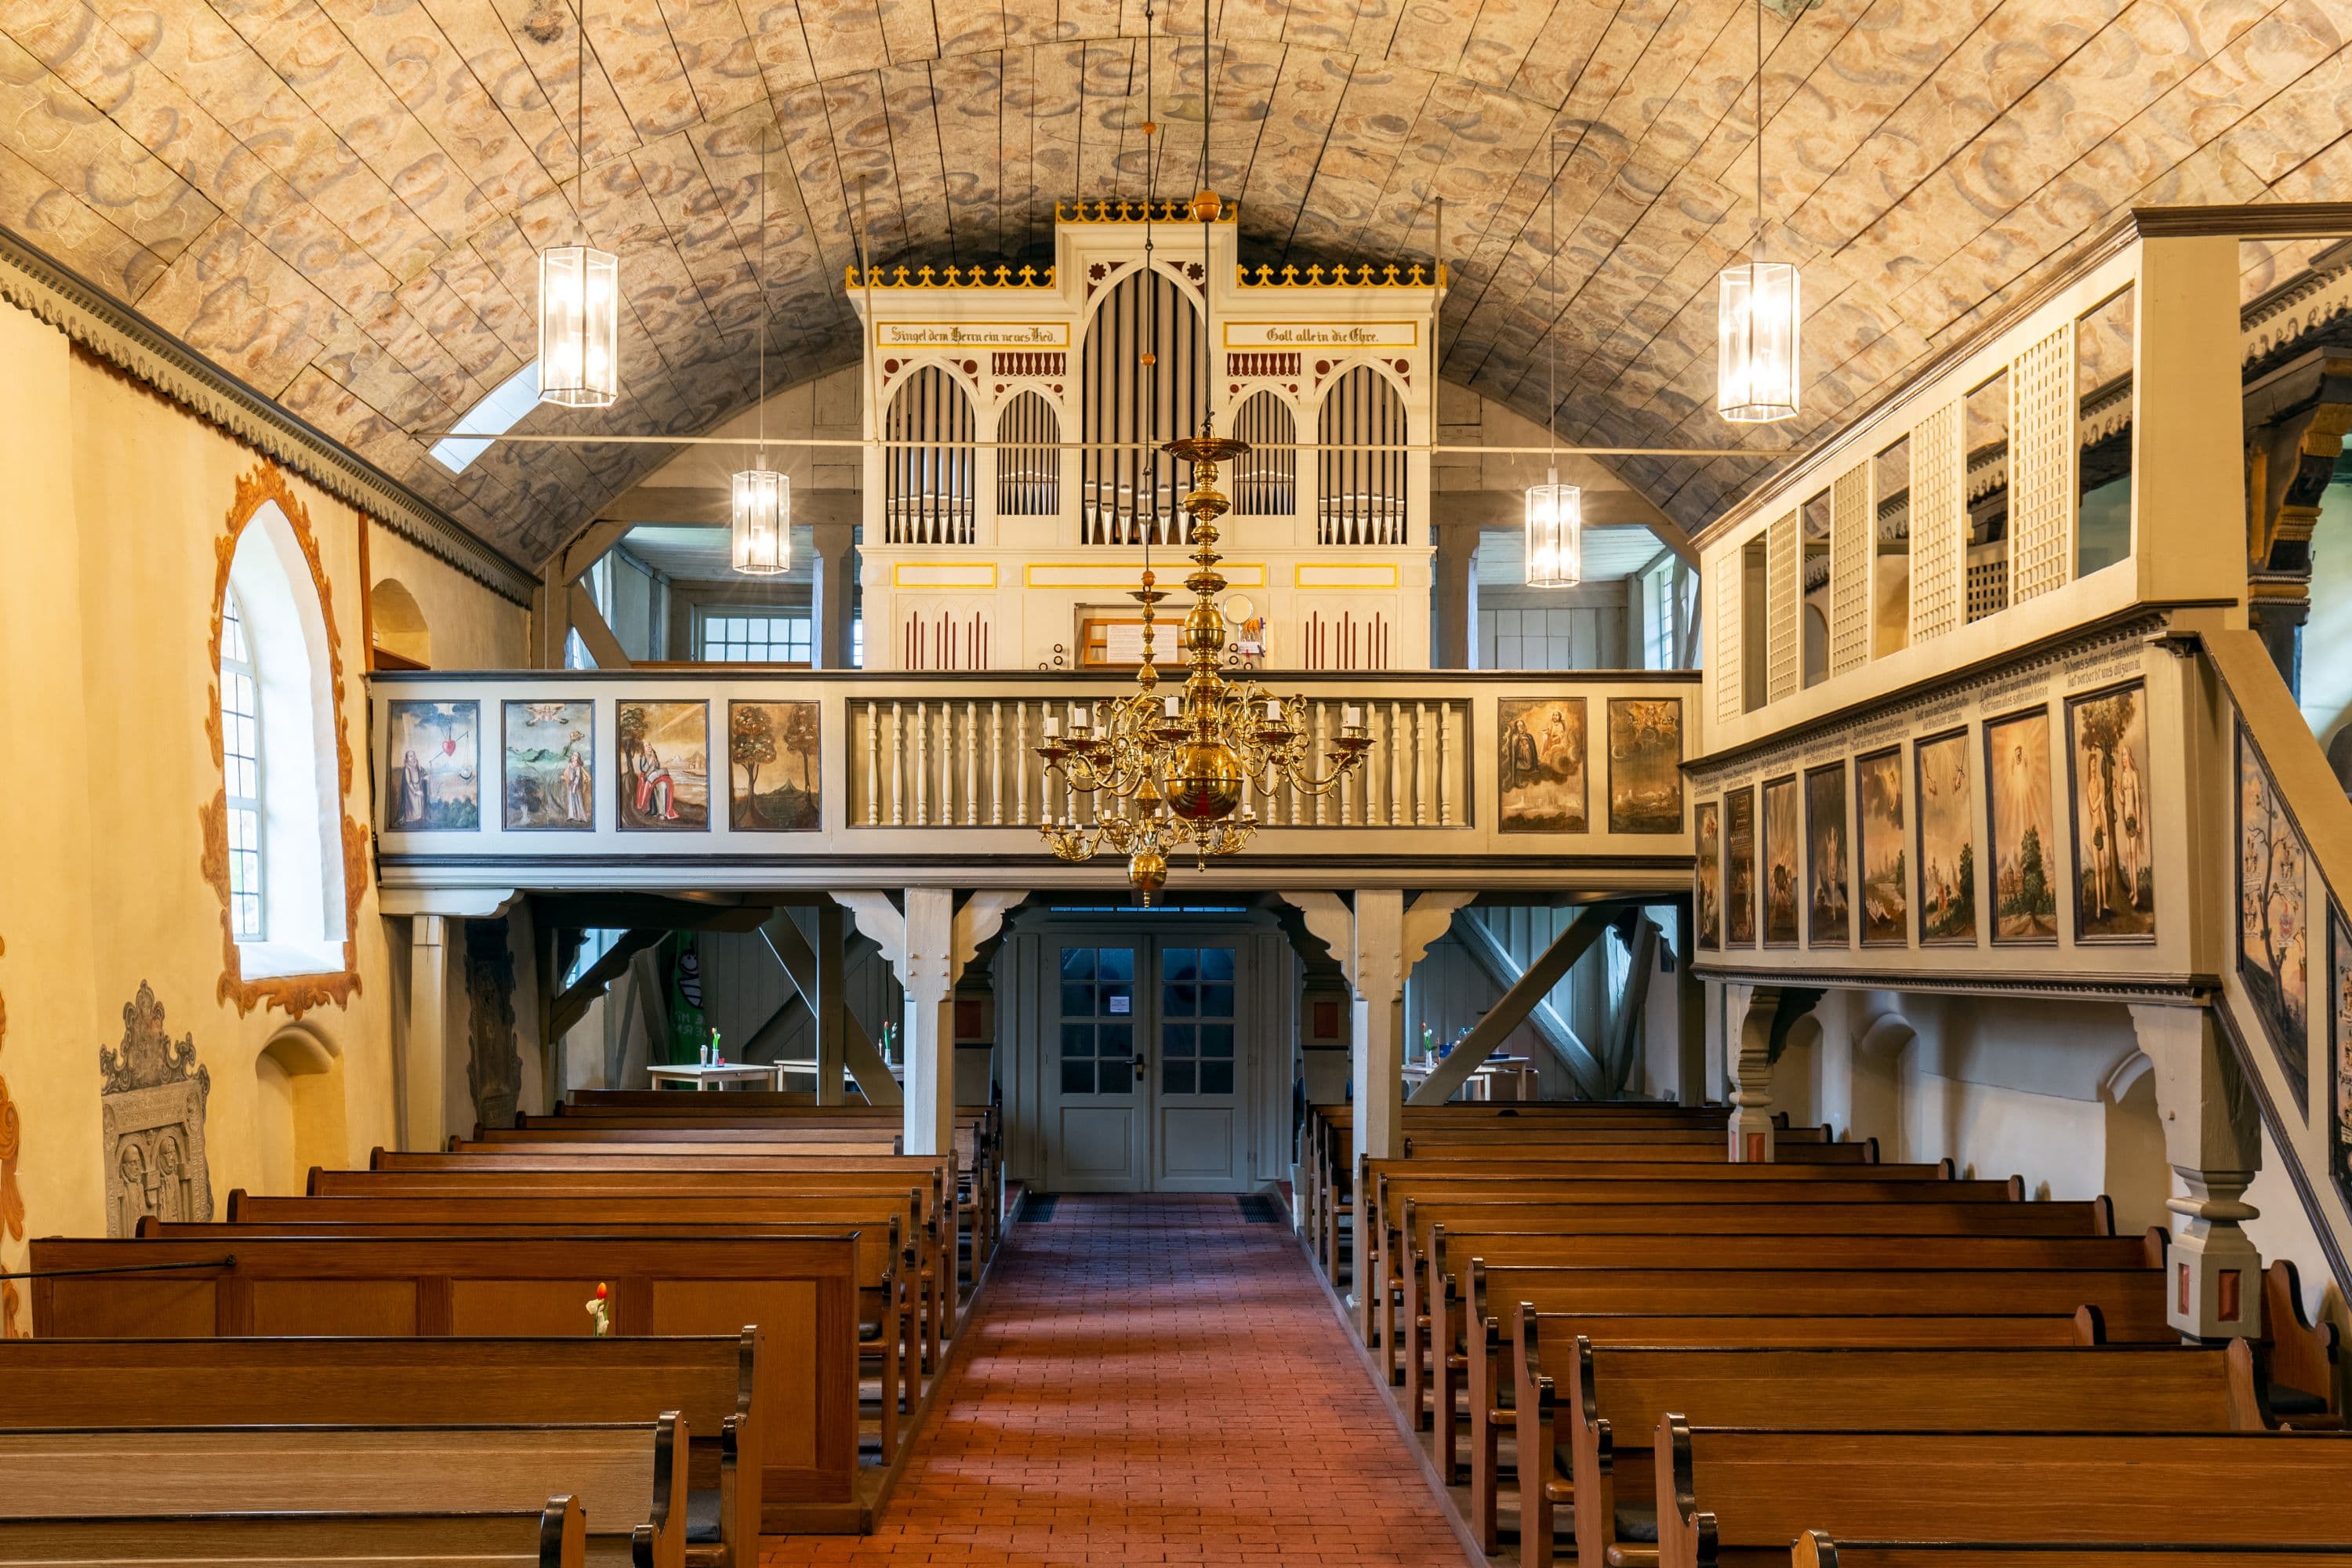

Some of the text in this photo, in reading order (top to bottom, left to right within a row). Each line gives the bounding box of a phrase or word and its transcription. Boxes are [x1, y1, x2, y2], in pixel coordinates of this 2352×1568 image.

[891, 326, 927, 343] Singet
[928, 328, 949, 342] dem
[983, 332, 999, 343] ein
[1000, 332, 1030, 343] neues
[1266, 328, 1293, 342] Gott
[1296, 328, 1329, 342] allein
[1331, 328, 1347, 342] die
